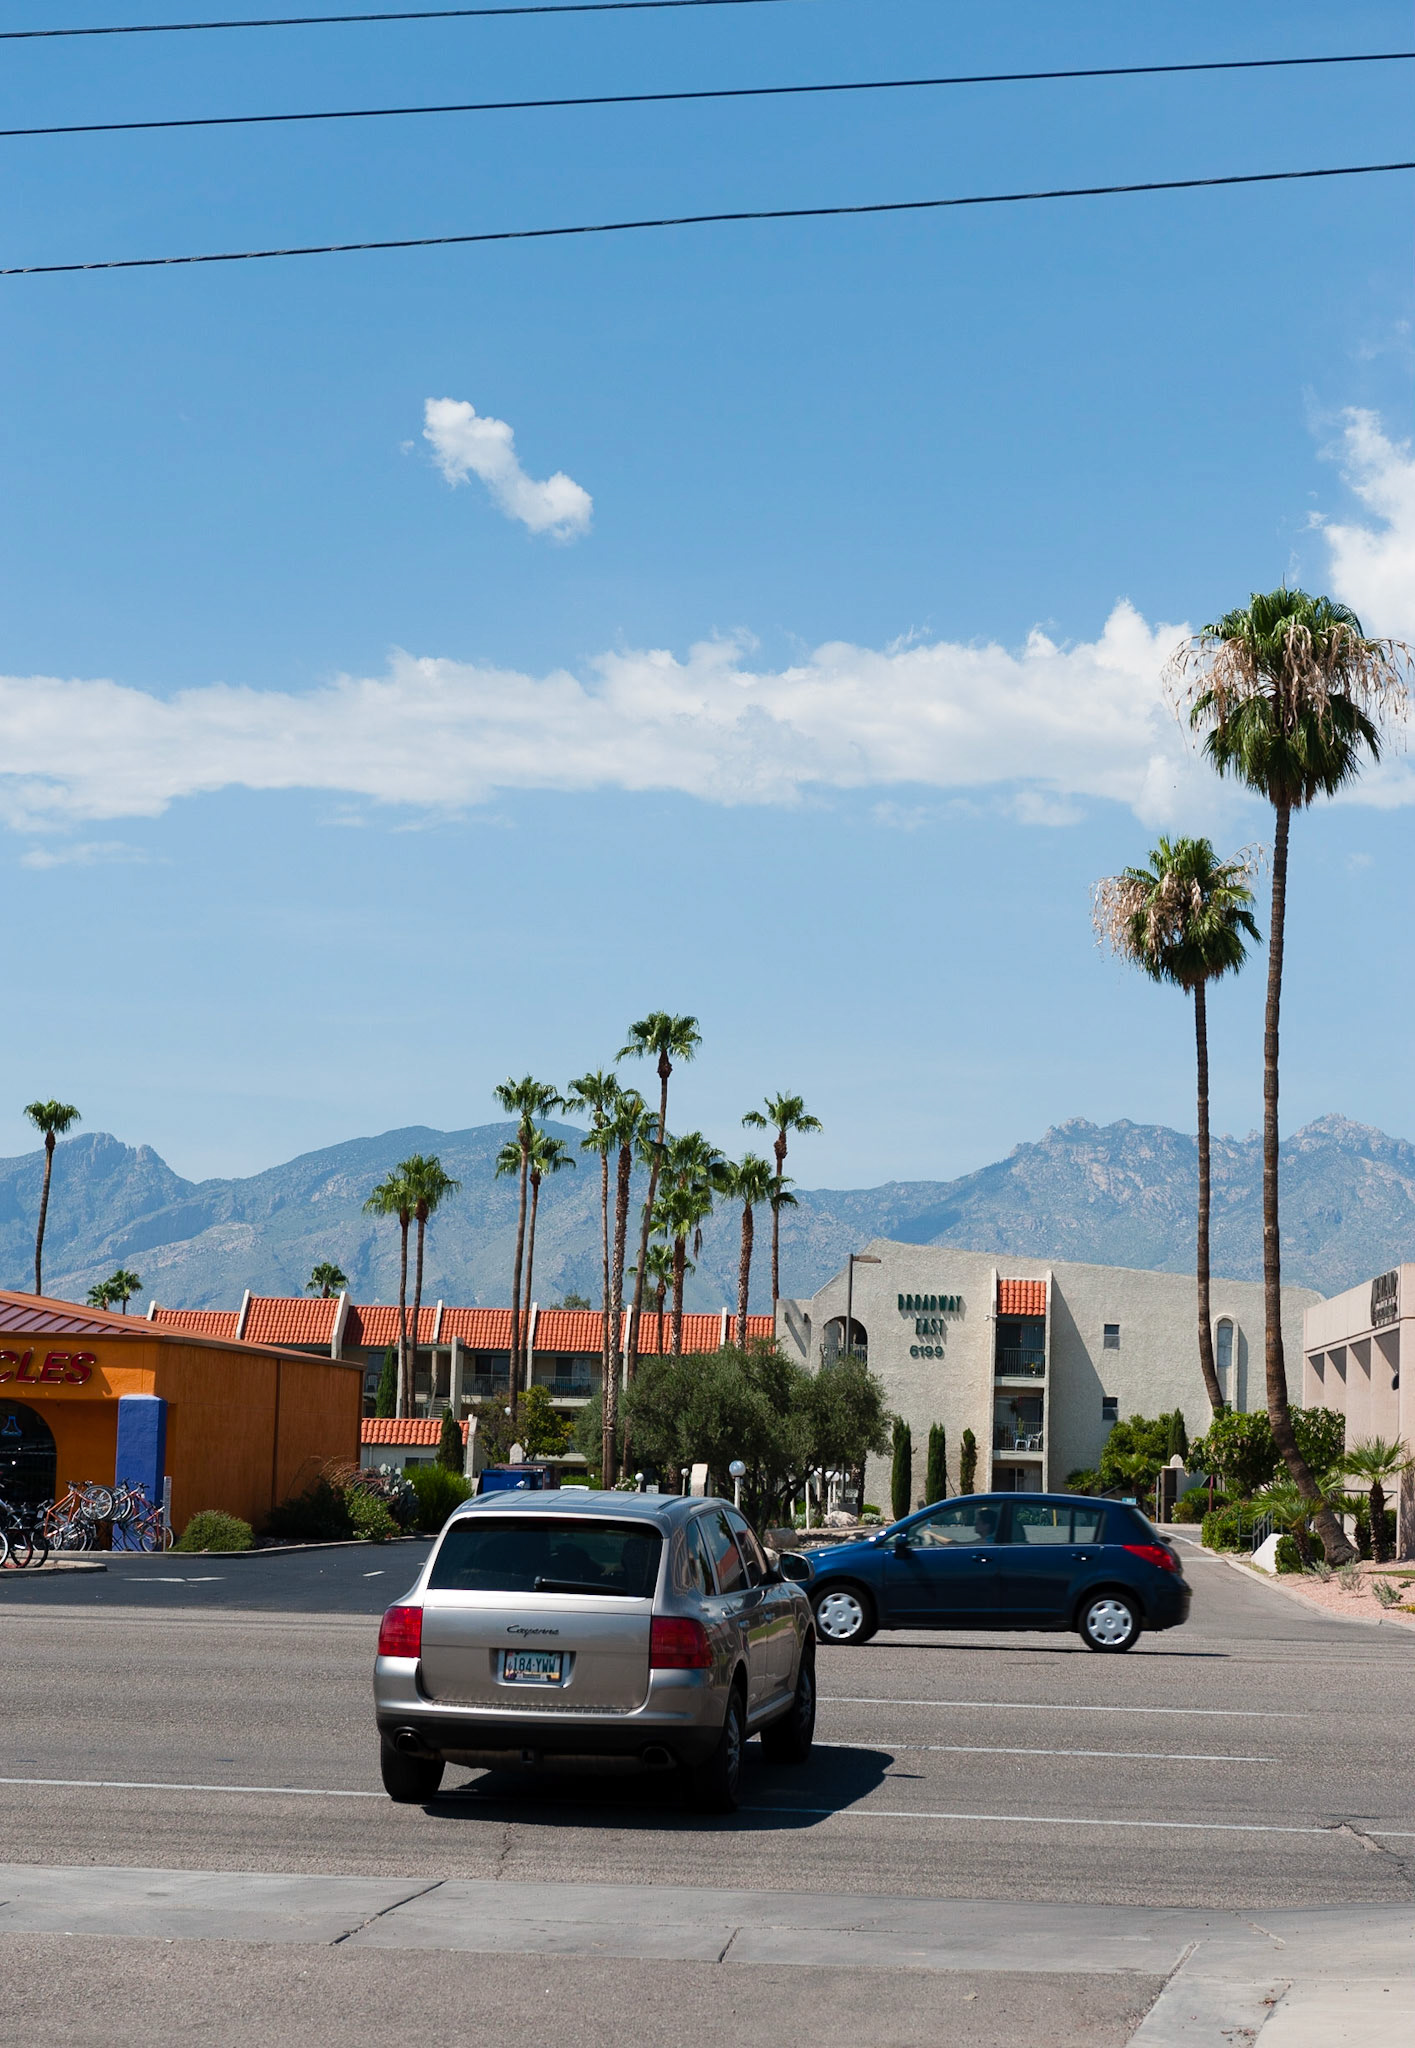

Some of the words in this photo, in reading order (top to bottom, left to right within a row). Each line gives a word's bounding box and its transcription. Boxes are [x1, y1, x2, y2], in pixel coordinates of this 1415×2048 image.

[898, 1294, 962, 1312] BROADWAY
[916, 1318, 944, 1335] EAST
[910, 1345, 943, 1357] 6199
[507, 1625, 559, 1637] Cayenne
